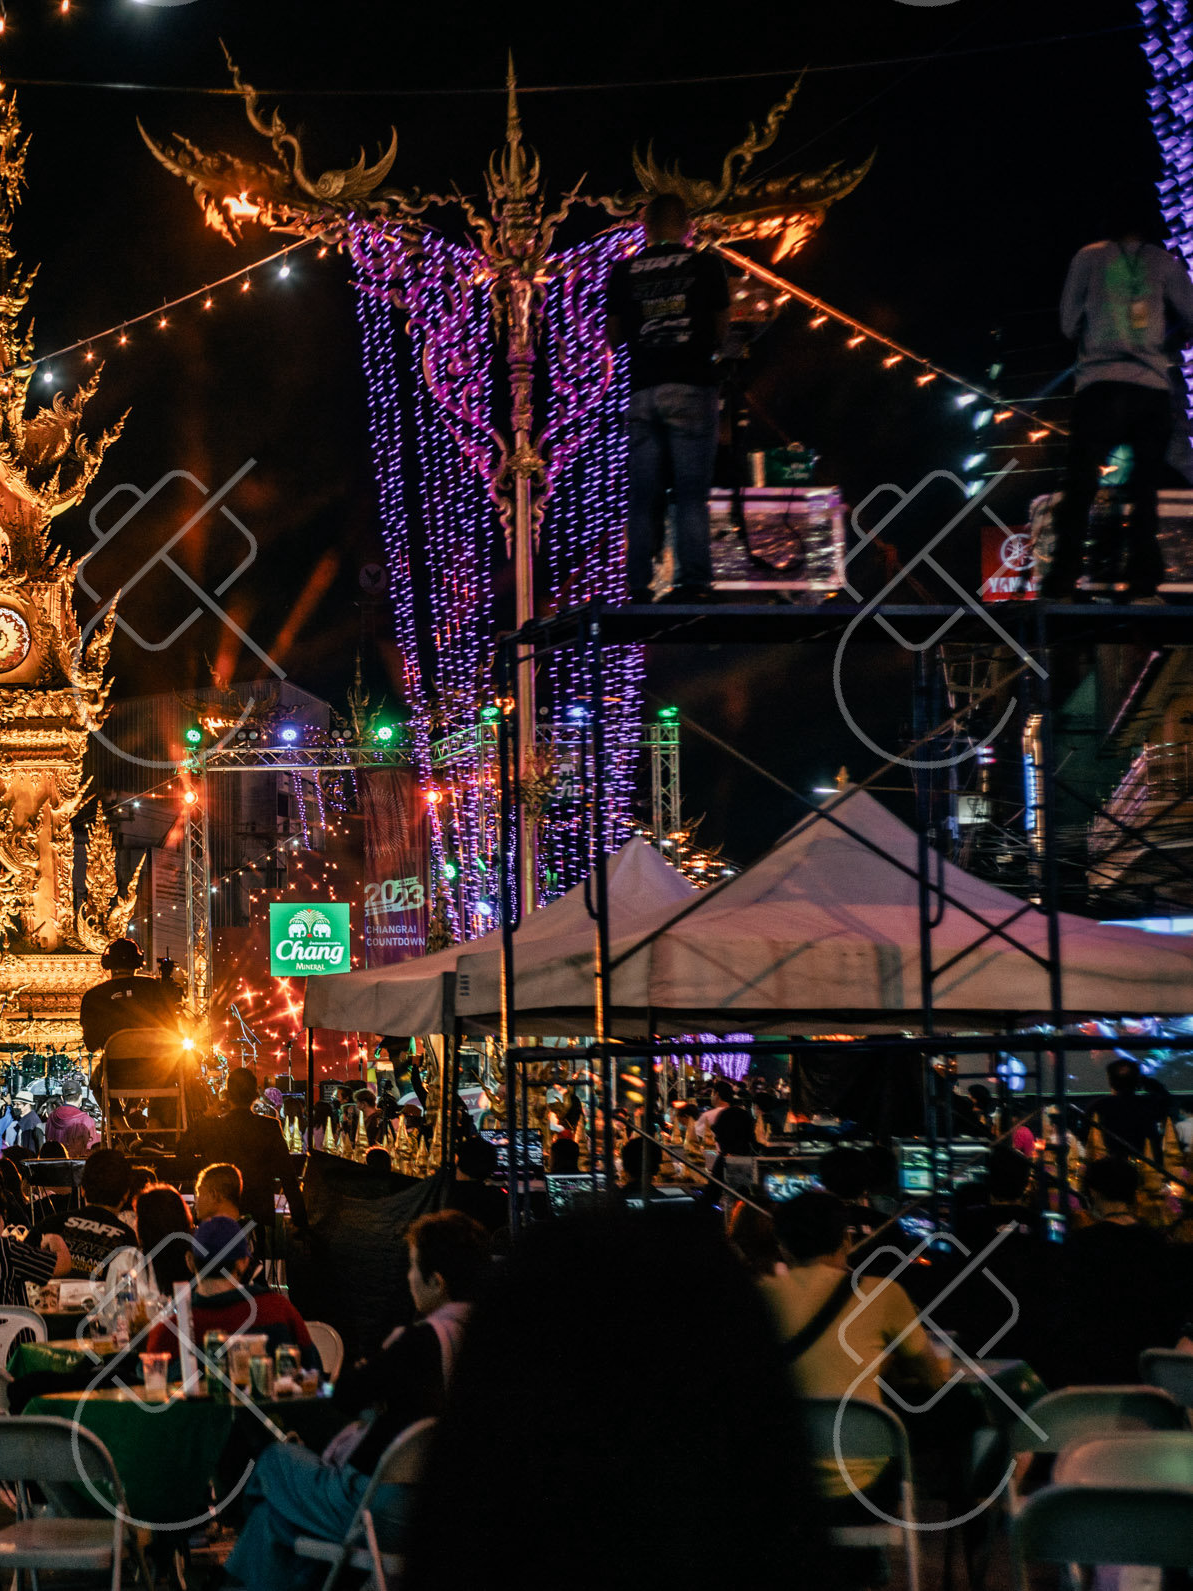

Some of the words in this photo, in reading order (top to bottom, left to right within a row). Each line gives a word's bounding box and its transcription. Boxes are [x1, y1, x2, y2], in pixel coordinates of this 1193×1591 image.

[629, 253, 694, 274] STAFF
[364, 879, 426, 914] 2023
[366, 924, 417, 935] CHIANGRAI
[275, 939, 345, 965] Chang
[366, 937, 426, 947] COUNTDOWN
[295, 962, 326, 971] MINERAL
[64, 1216, 126, 1239] STAFF
